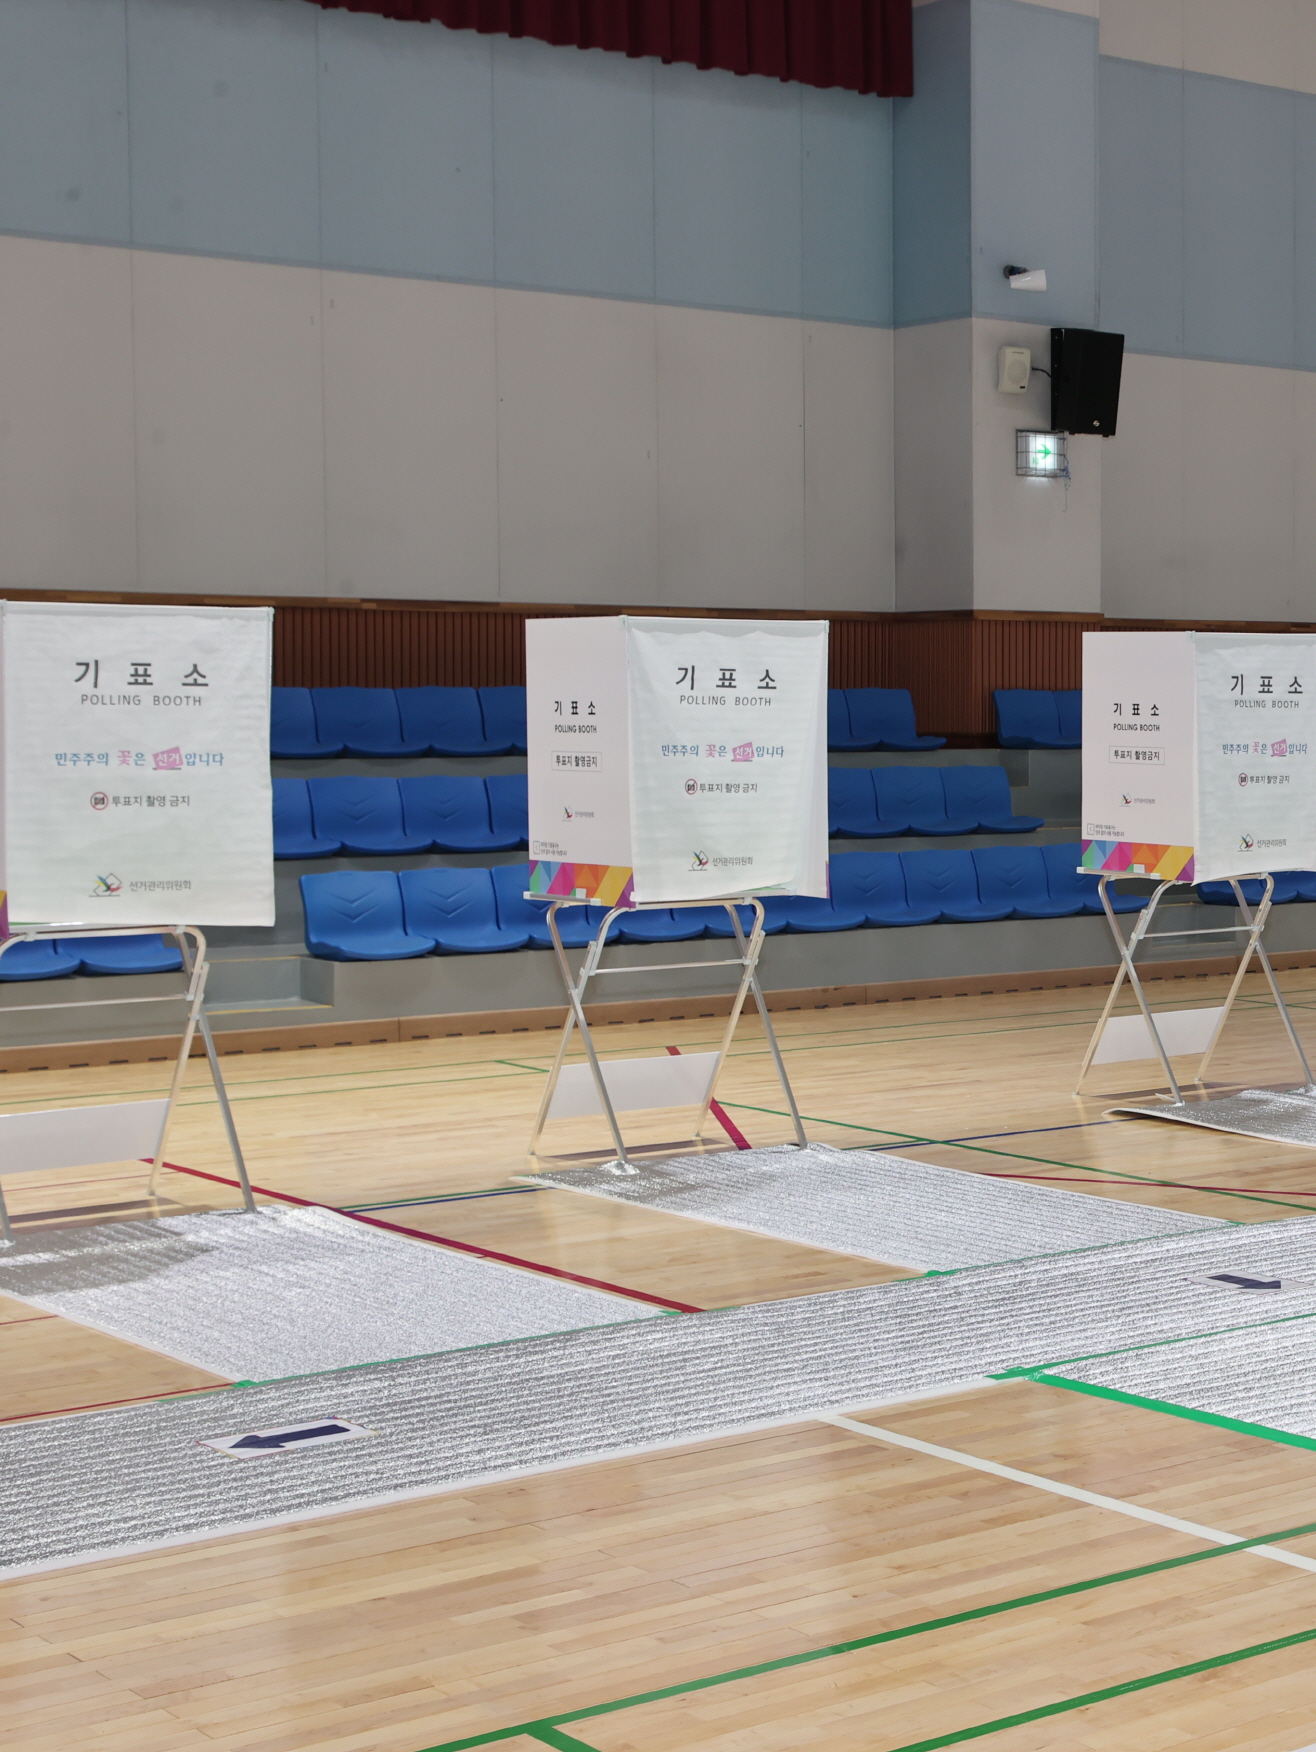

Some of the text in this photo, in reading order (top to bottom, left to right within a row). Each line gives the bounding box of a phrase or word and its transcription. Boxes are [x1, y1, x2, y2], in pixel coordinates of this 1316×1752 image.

[74, 659, 209, 688] 기표소
[675, 665, 777, 690] 기표소
[1230, 674, 1303, 695] 기표소
[81, 694, 202, 706] POLLING BOOTH
[679, 695, 771, 706] POLLING BOOTH
[1234, 700, 1299, 709] POLLING BOOTH
[554, 700, 596, 716] 기표소
[1113, 703, 1159, 716] 기표소
[554, 724, 597, 734] POLLING BOOTH
[1113, 723, 1160, 732] POLLING BOOTH
[661, 744, 699, 757] 민주주의
[705, 744, 727, 758] 꽃은
[1222, 743, 1249, 754] 민주주의
[1252, 741, 1268, 754] 꽃은
[54, 752, 109, 767] 민주주의
[117, 750, 146, 767] 꽃은
[556, 755, 598, 768] 투표지 촬영금지
[1113, 750, 1160, 761] 투표지 촬영금지
[1249, 776, 1290, 784] 투표지 촬영 금지
[699, 783, 758, 793] 투표지 촬영 금지
[111, 795, 190, 807] 투표지 촬영 금지
[1256, 838, 1287, 848] 선거관리위원회
[712, 856, 753, 867] 선거관리위원회
[129, 879, 192, 892] 선거관리위원회
